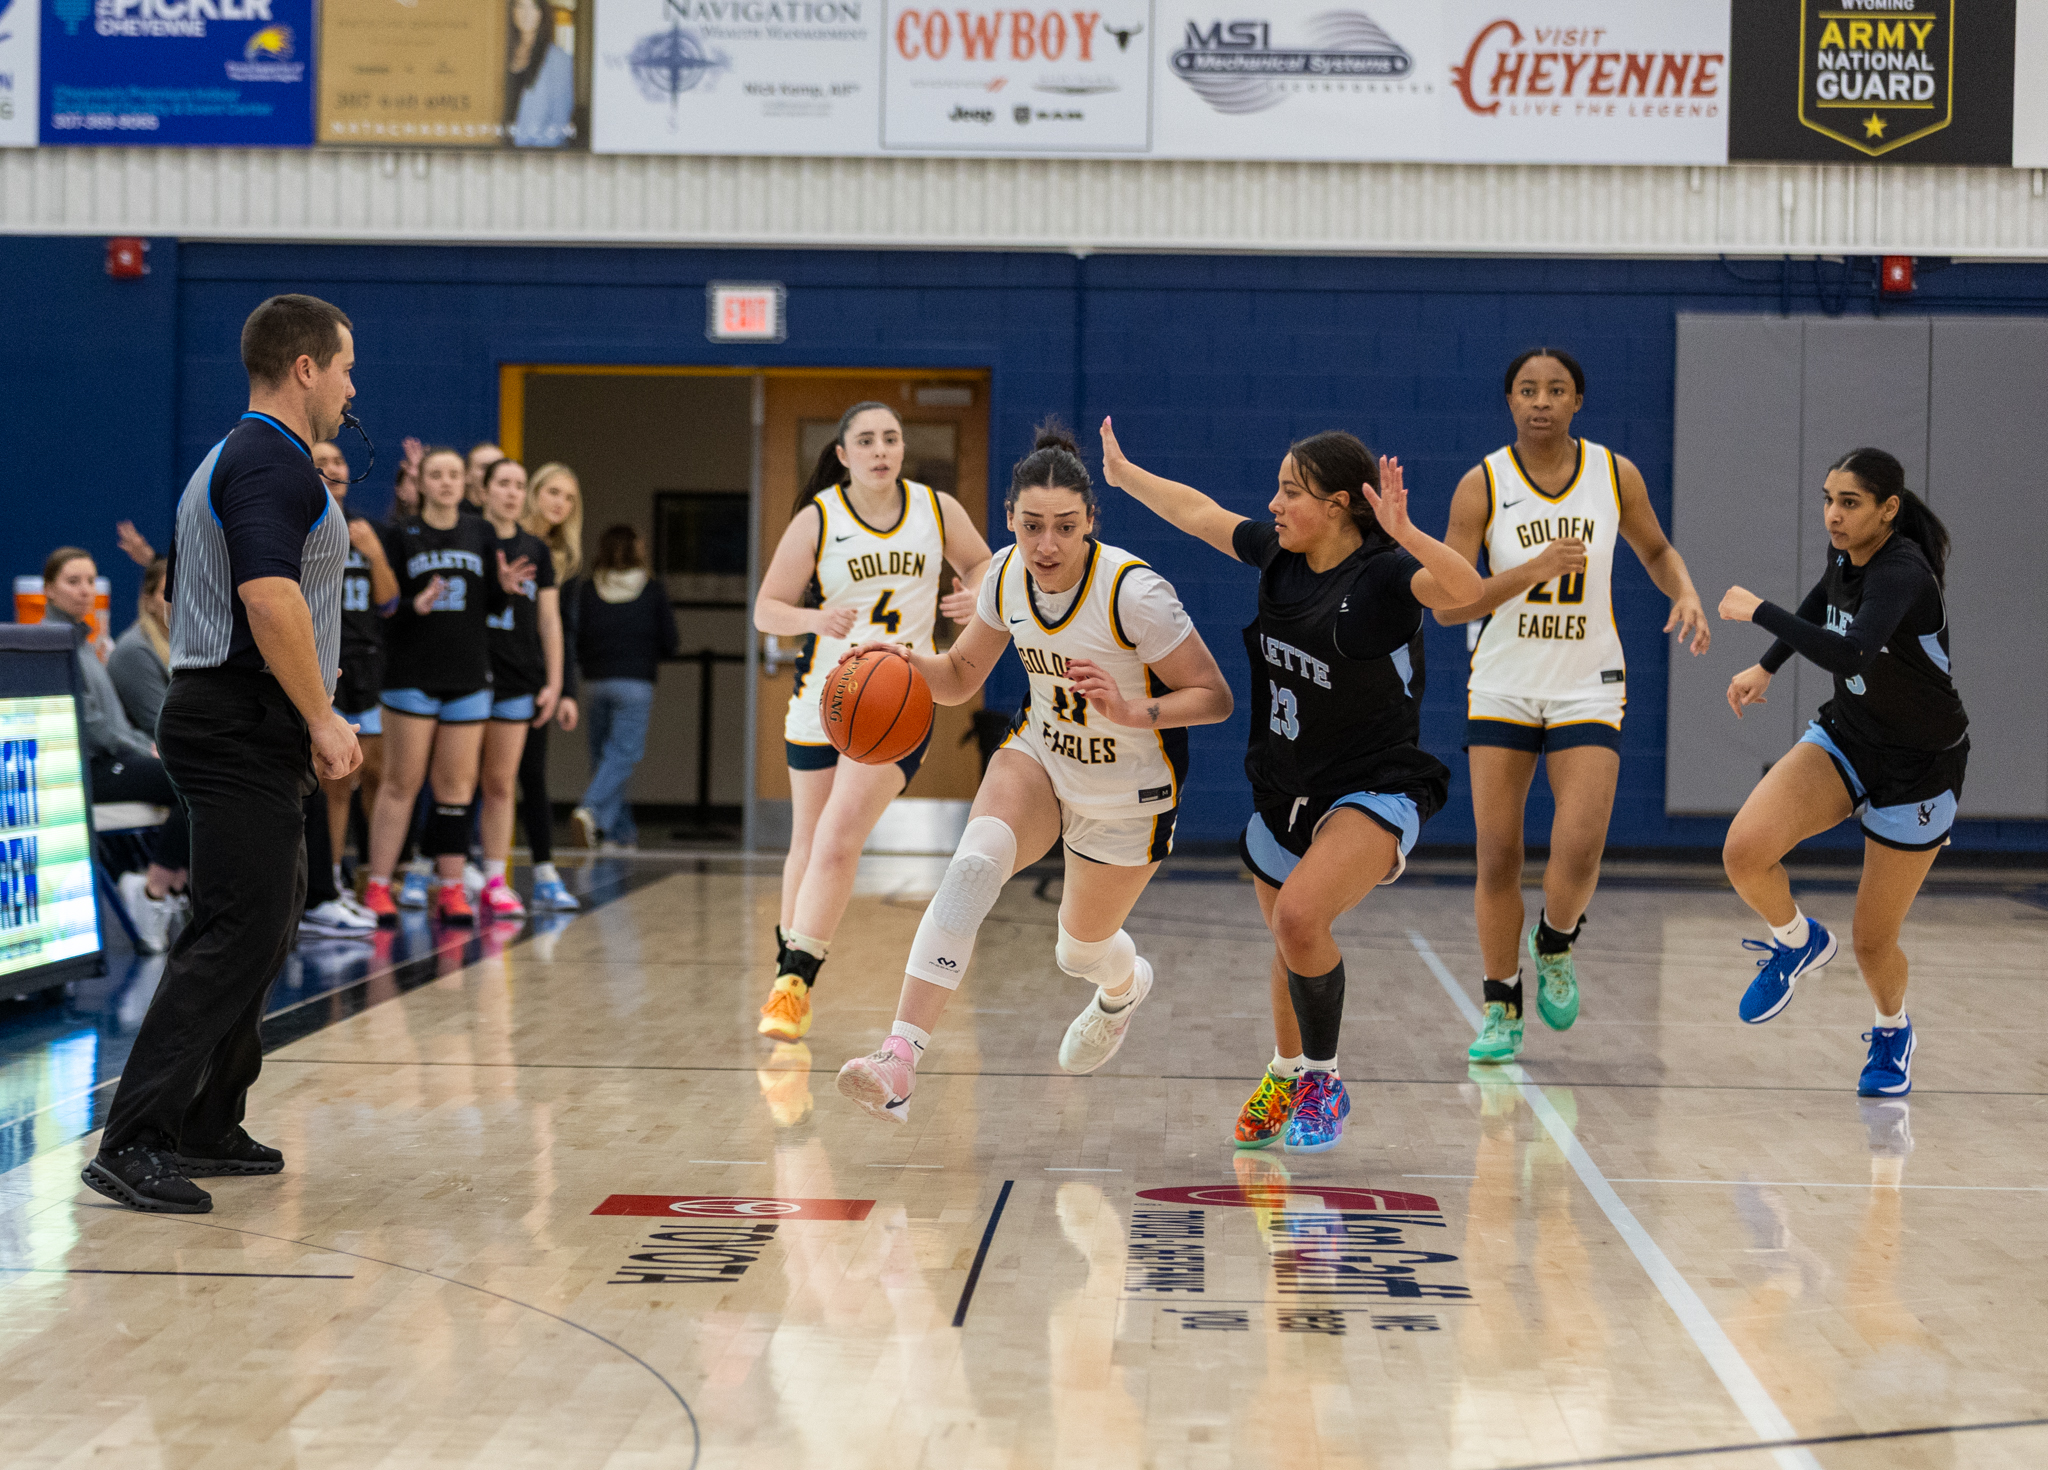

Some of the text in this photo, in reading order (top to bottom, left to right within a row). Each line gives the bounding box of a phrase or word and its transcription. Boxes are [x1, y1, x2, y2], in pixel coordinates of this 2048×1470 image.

[662, 0, 861, 23] NAVIGATION
[1842, 0, 1914, 11] WYOMING
[94, 20, 206, 37] CHEYENNE
[896, 9, 1101, 62] COWBOY
[1186, 21, 1269, 50] MSI
[1533, 27, 1607, 47] VISIT
[1819, 20, 1934, 50] ARMY
[1192, 55, 1394, 75] Mechanical Systems
[1449, 19, 1725, 117] CHEYENNE
[1817, 50, 1935, 71] NATIONAL
[1816, 72, 1935, 100] GUARD
[949, 105, 995, 127] Jeep
[1509, 103, 1720, 118] LIVE THE LEGEND
[1516, 516, 1595, 549] GOLDEN
[848, 551, 927, 583] GOLDEN
[870, 588, 902, 635] 4
[1518, 613, 1586, 640] EAGLES
[1051, 684, 1088, 728] 11
[1270, 679, 1300, 741] 23
[1042, 720, 1118, 764] EAGLES
[606, 1223, 780, 1285] TOYOTA
[1124, 1210, 1206, 1293] TOYOTA CHEYENNE
[1267, 1211, 1474, 1299] Ken Garff
[1161, 1308, 1250, 1331] you
[1276, 1308, 1369, 1335] hear
